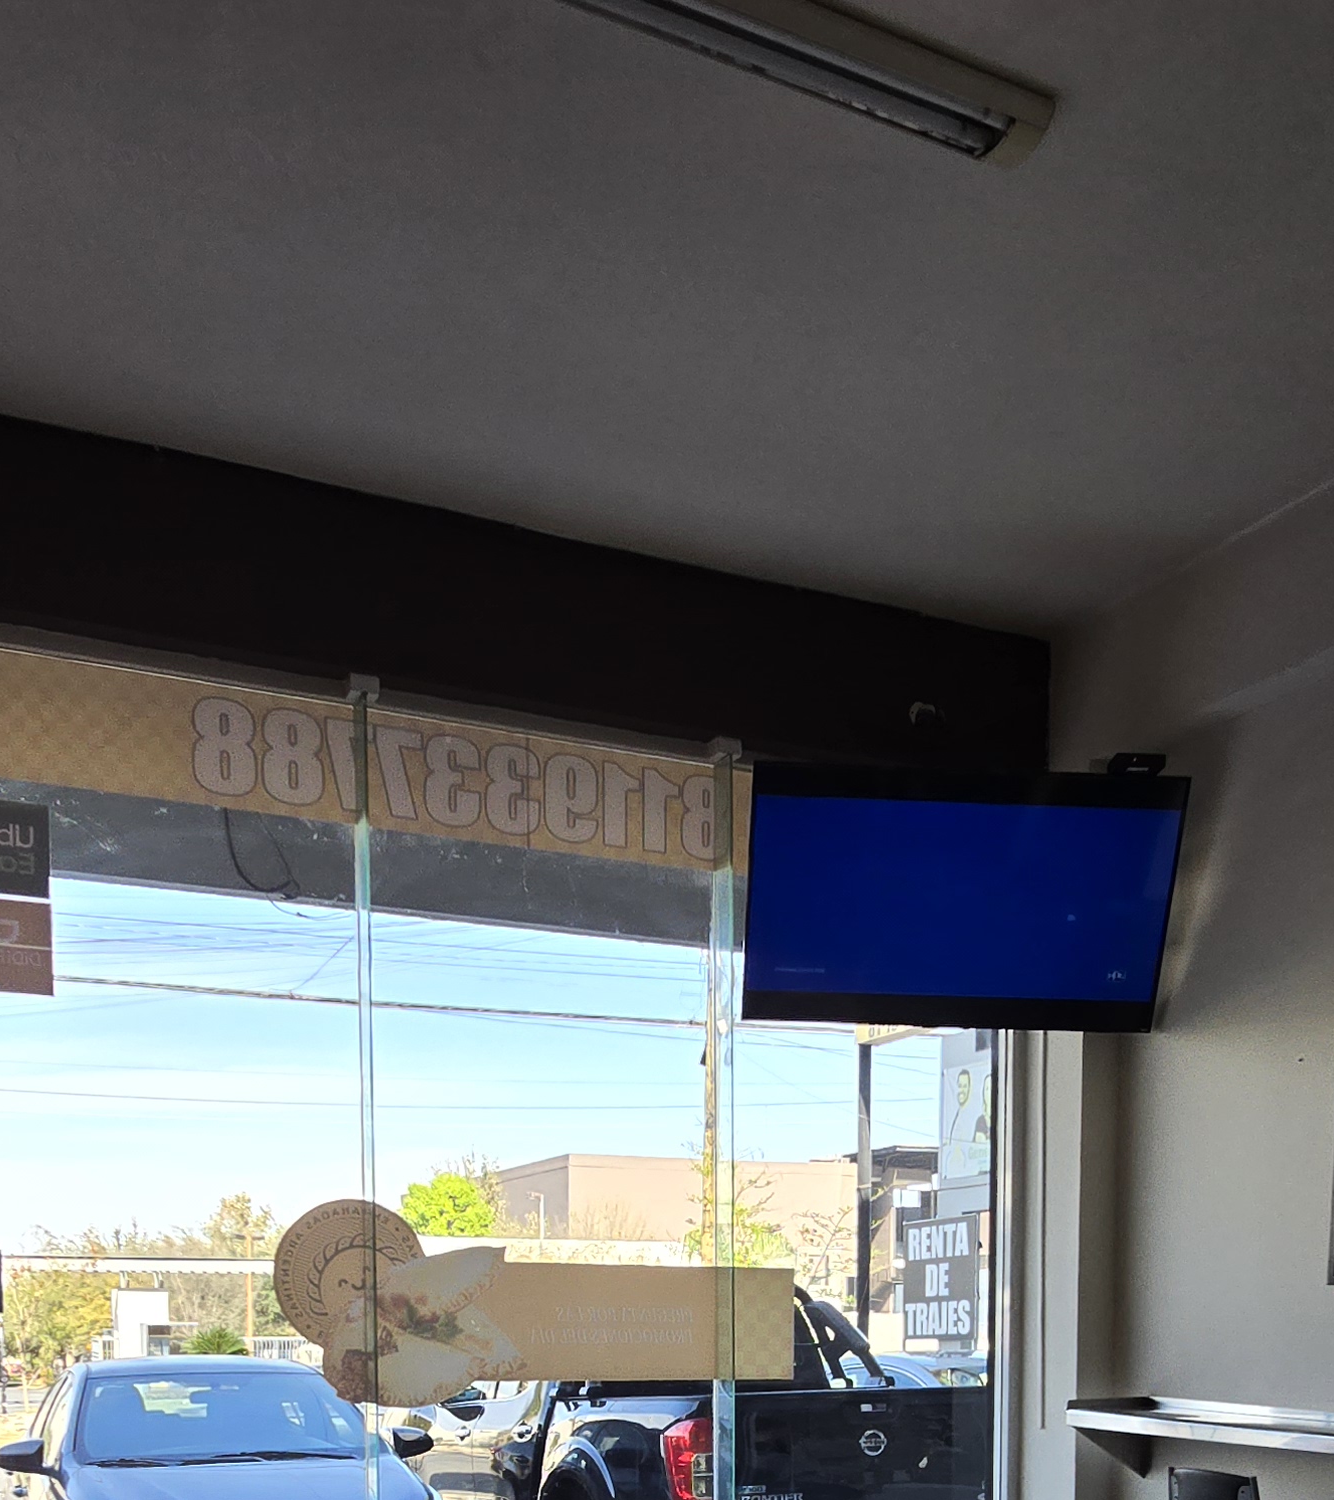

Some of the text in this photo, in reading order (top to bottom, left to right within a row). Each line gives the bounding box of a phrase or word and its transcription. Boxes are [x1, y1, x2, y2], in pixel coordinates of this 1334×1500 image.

[907, 1222, 969, 1261] RENTA
[925, 1263, 949, 1297] DE
[905, 1300, 971, 1336] TRAJES
